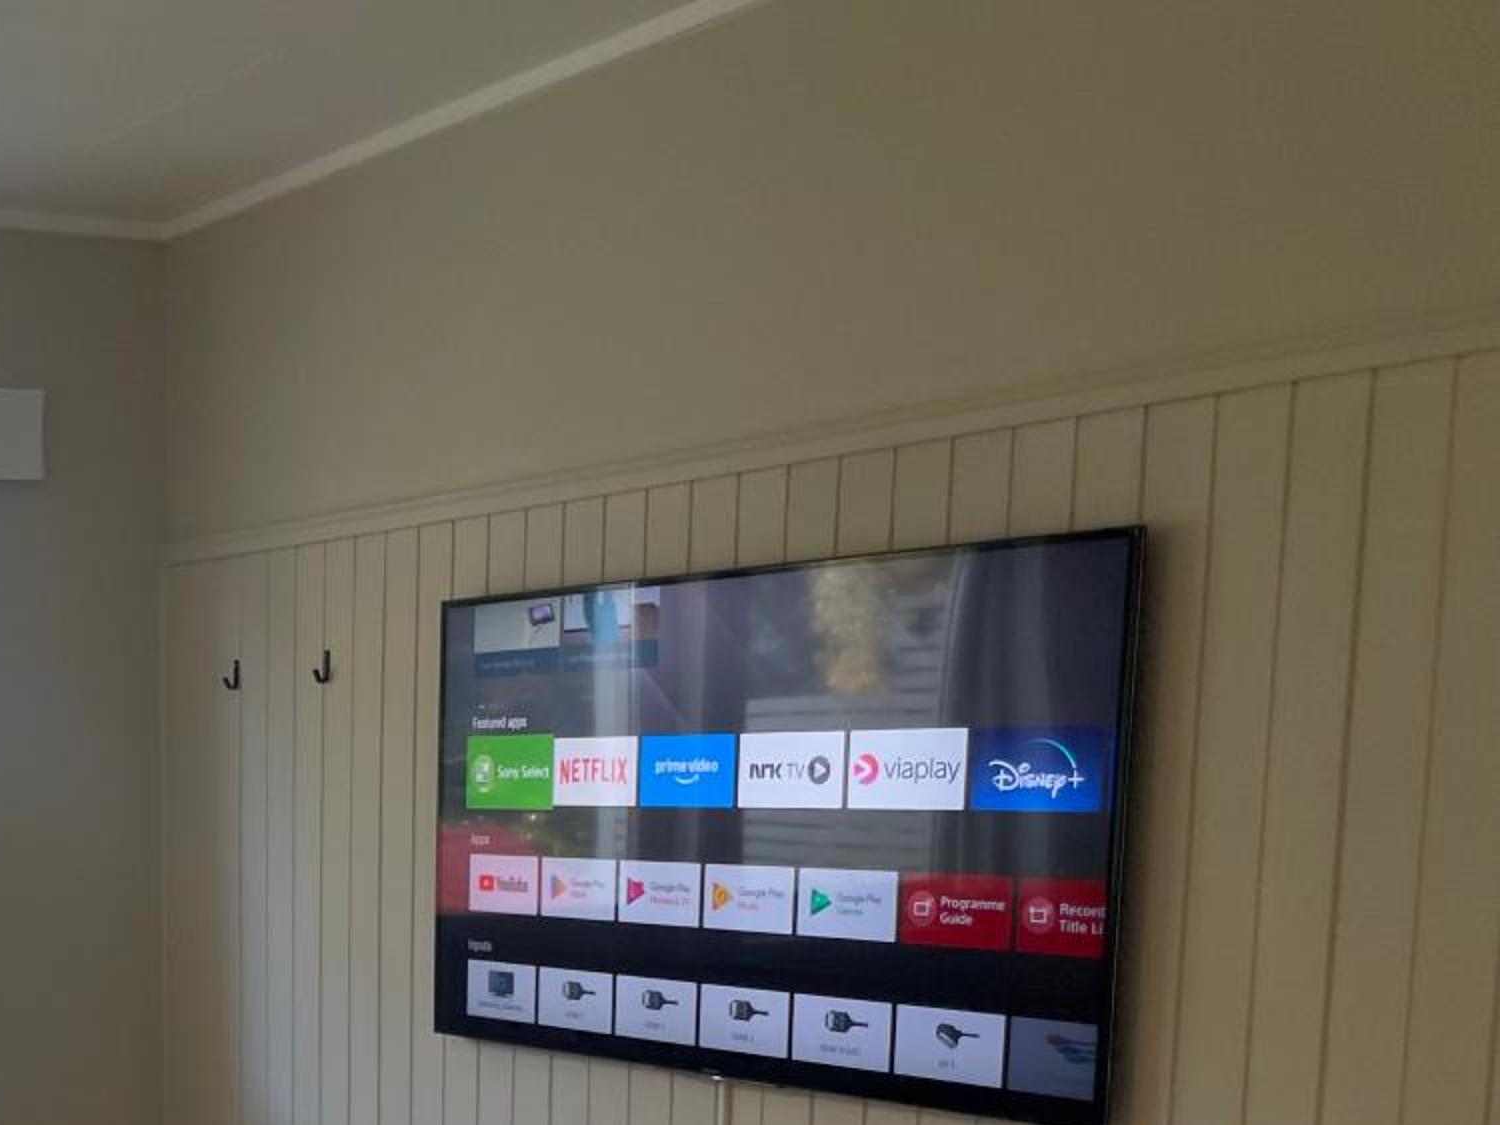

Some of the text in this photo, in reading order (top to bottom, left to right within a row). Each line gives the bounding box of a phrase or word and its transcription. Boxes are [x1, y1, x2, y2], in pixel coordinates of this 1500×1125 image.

[497, 764, 549, 781] Sony Select
[560, 757, 627, 784] NETFLIX
[884, 757, 960, 784] viaplay
[940, 896, 1005, 912] Programme
[940, 912, 973, 926] Guide
[1060, 919, 1088, 933] Title
